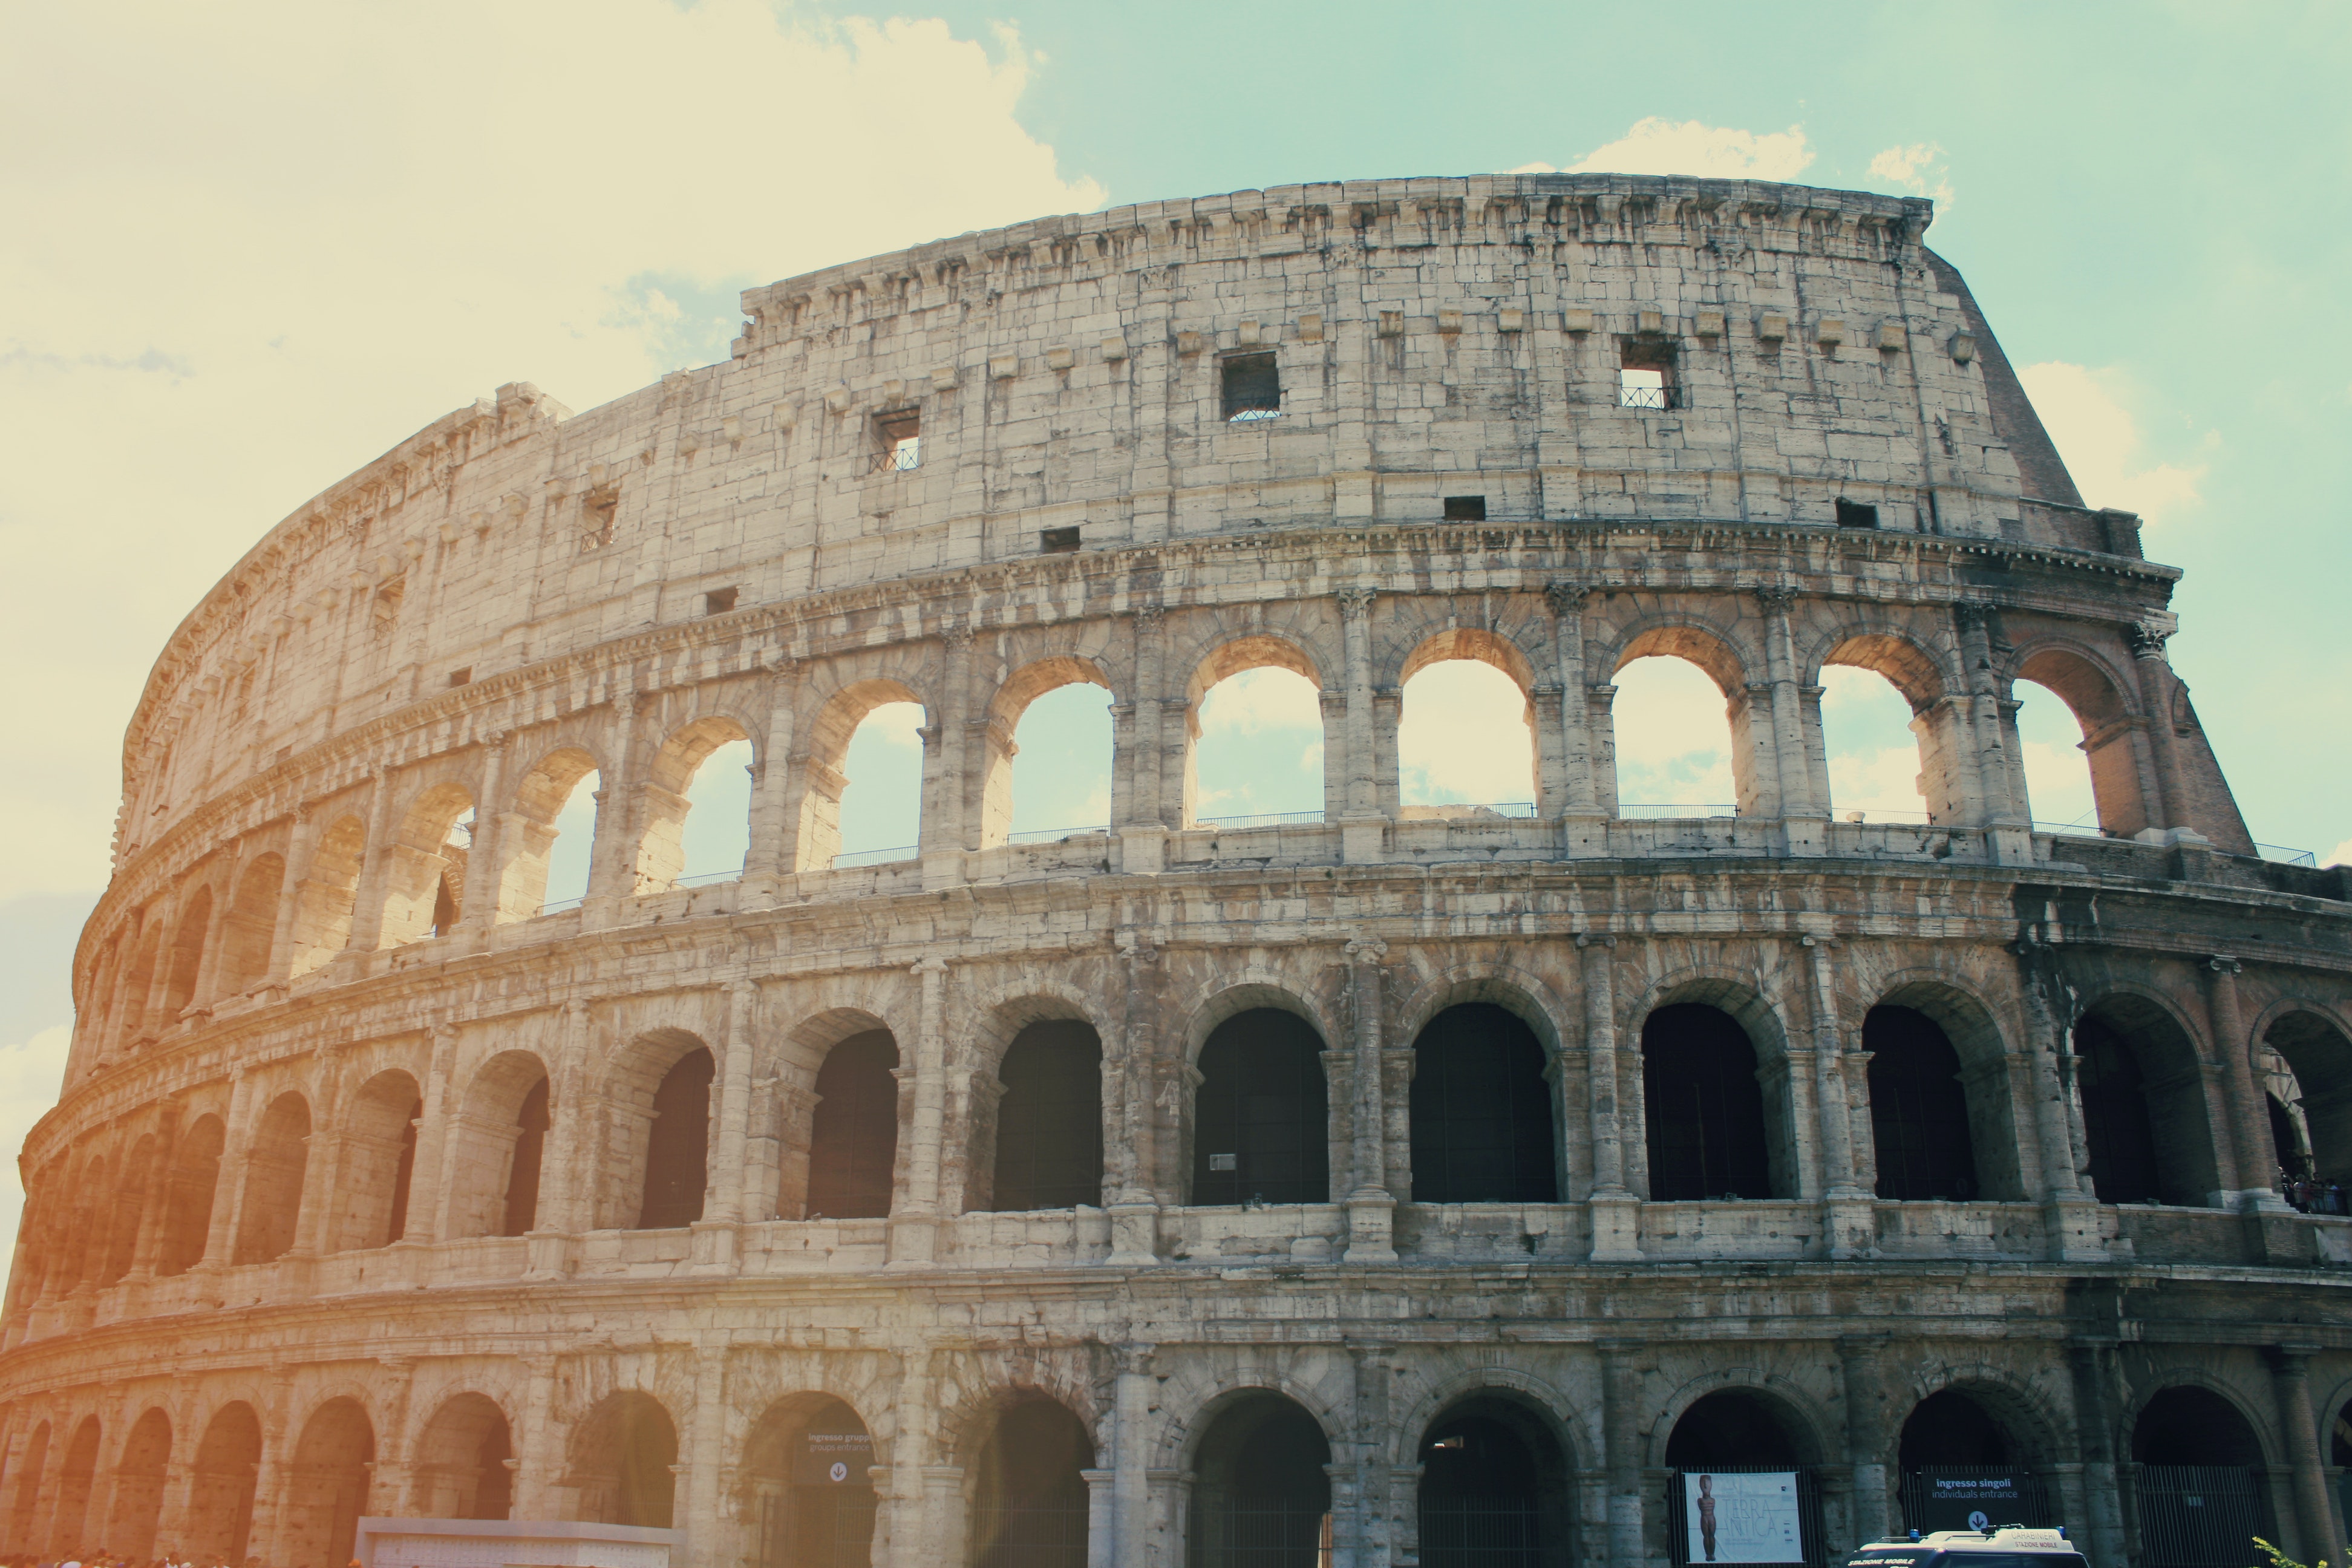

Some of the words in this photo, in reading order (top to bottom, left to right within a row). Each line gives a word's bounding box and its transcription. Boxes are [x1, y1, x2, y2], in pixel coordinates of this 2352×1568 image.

[1936, 1478, 1977, 1489] ingresso
[1979, 1478, 2011, 1489] singoli
[1932, 1489, 1978, 1498] individuals
[1979, 1490, 2018, 1498] entrance
[1722, 1499, 1772, 1519] TERRA
[1723, 1517, 1778, 1537] ANTICA
[2011, 1531, 2056, 1540] CARABINIERI
